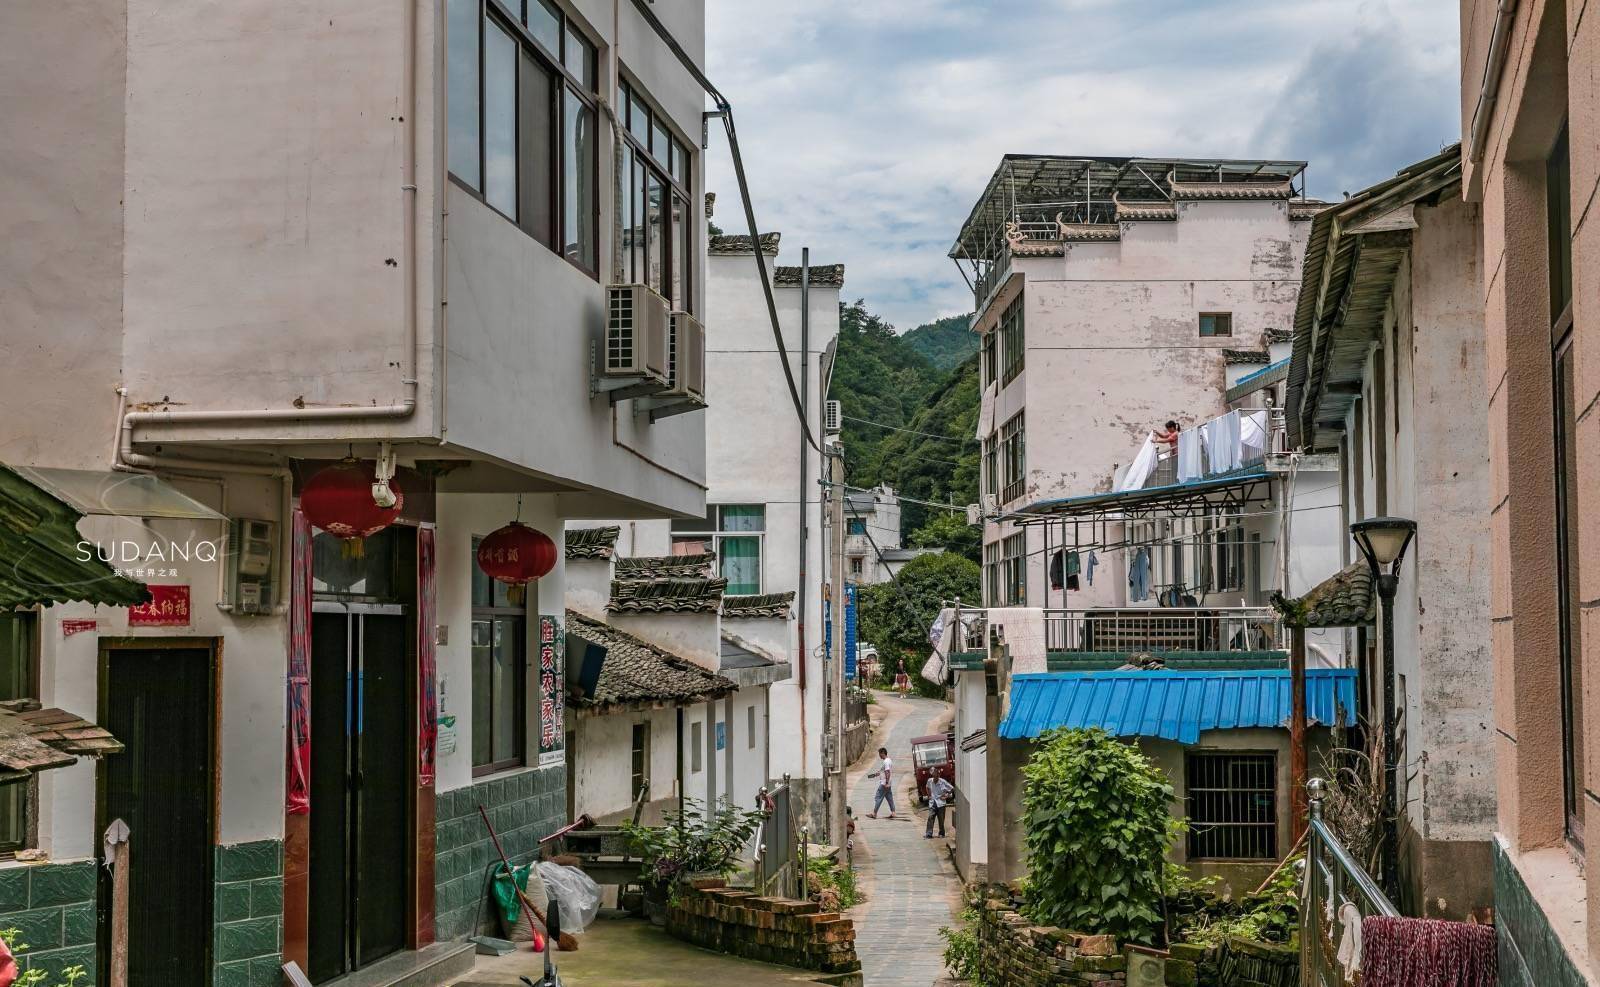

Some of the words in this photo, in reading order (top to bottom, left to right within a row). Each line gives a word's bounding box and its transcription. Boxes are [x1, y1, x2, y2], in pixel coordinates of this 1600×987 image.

[541, 619, 555, 748] 胜家农家乐
